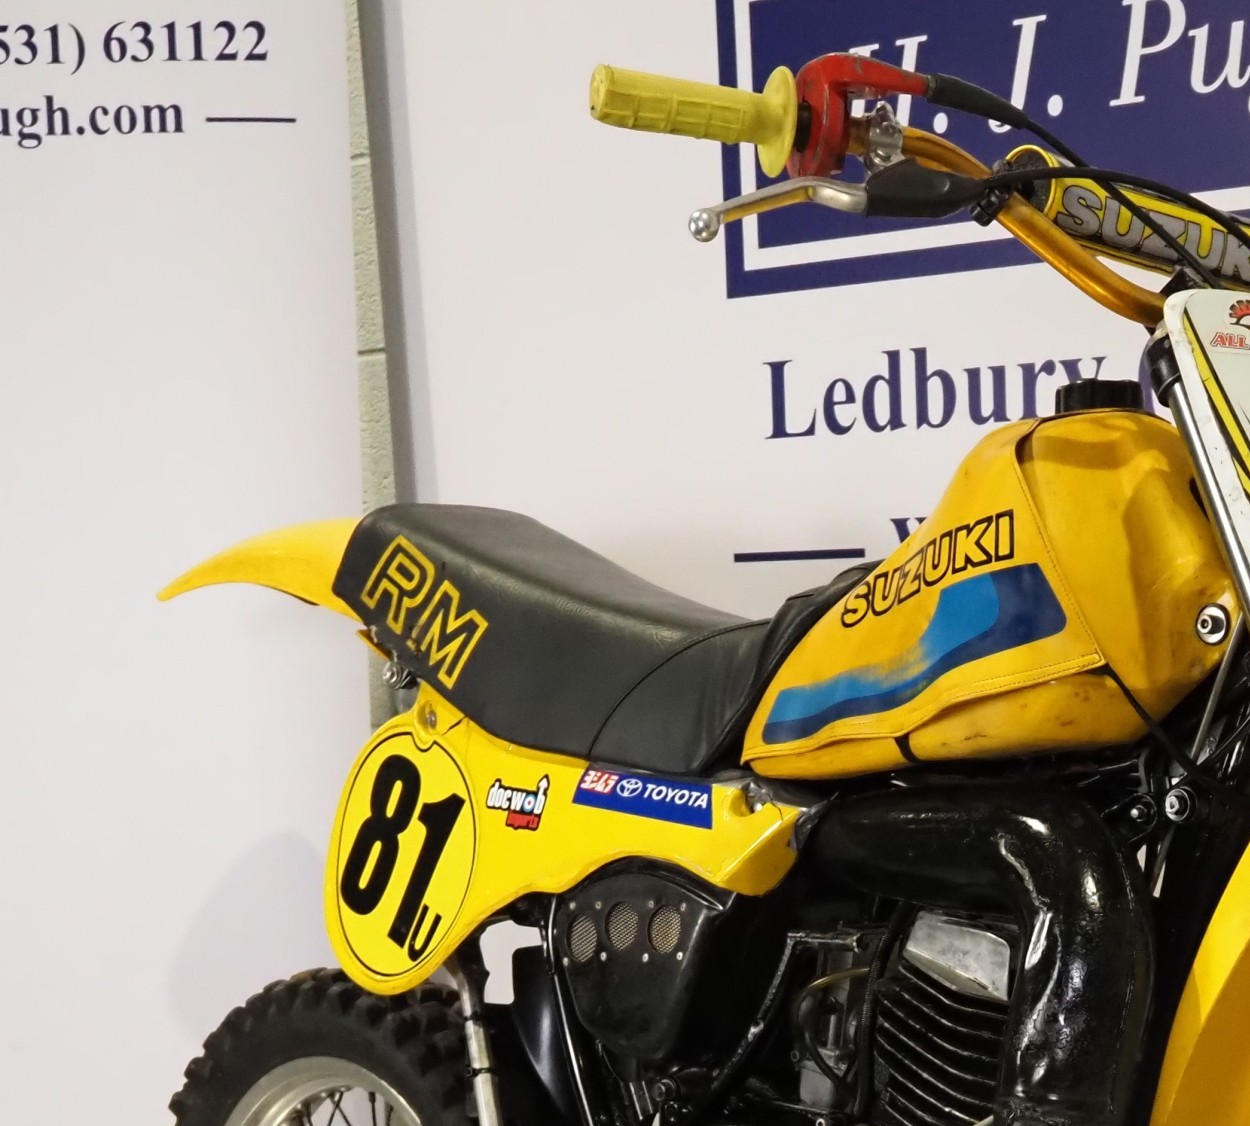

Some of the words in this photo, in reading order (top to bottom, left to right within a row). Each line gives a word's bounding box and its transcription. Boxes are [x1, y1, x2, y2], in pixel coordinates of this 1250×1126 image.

[103, 20, 268, 63] 631122
[1210, 331, 1250, 350] ALL
[763, 346, 1107, 440] Ledbur
[841, 508, 1015, 629] SUZUKI
[360, 534, 490, 690] RM
[643, 783, 709, 809] TOYOTA
[340, 754, 467, 950] 81
[407, 903, 443, 962] U
